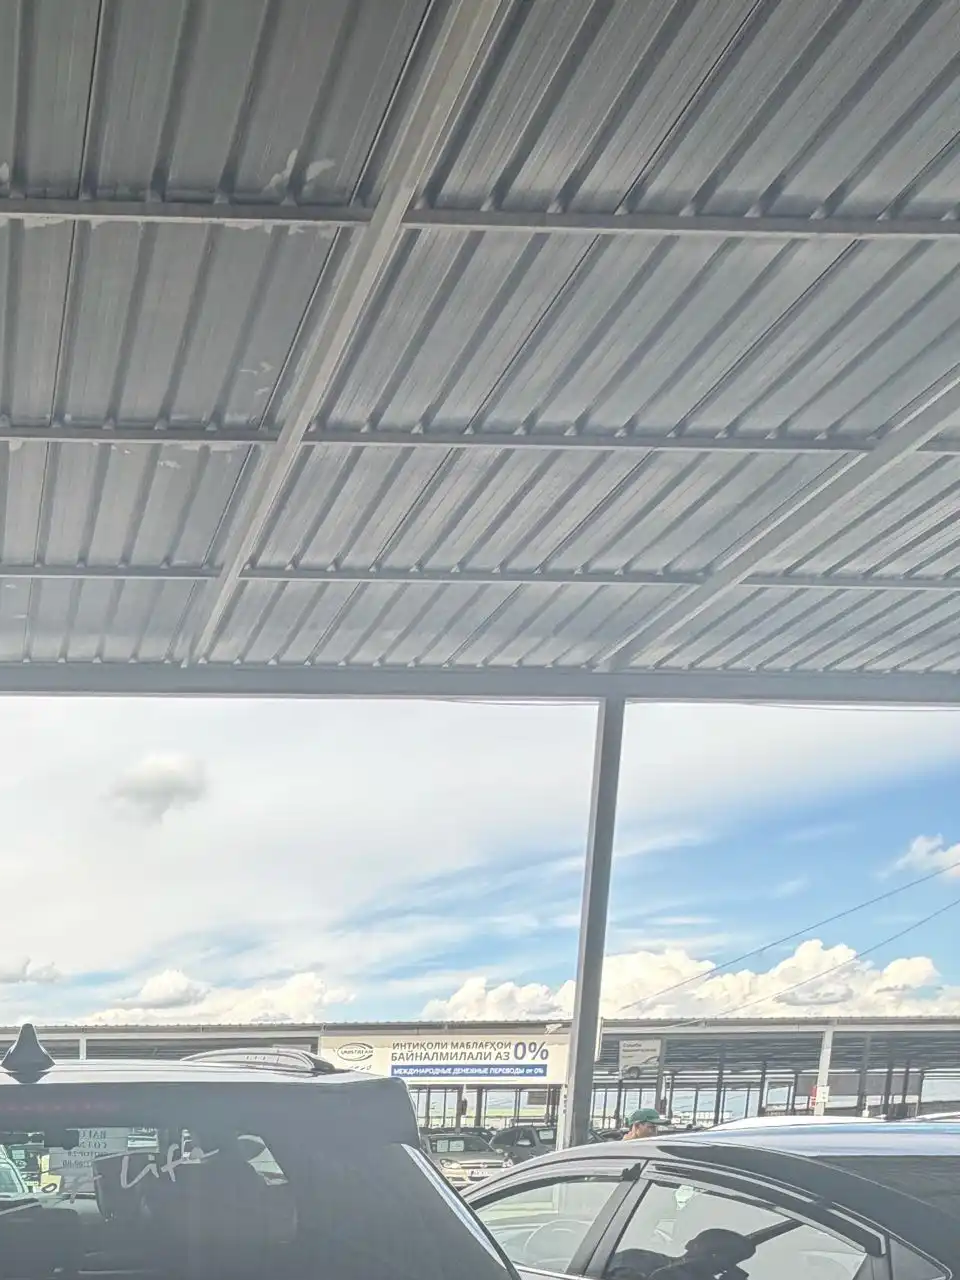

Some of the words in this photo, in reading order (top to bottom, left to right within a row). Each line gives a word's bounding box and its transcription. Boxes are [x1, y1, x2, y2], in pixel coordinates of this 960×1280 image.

[391, 1050, 492, 1062] БАЙНАЛМИЛАЛИ
[495, 1051, 510, 1061] АЗ
[513, 1041, 549, 1061] 0%
